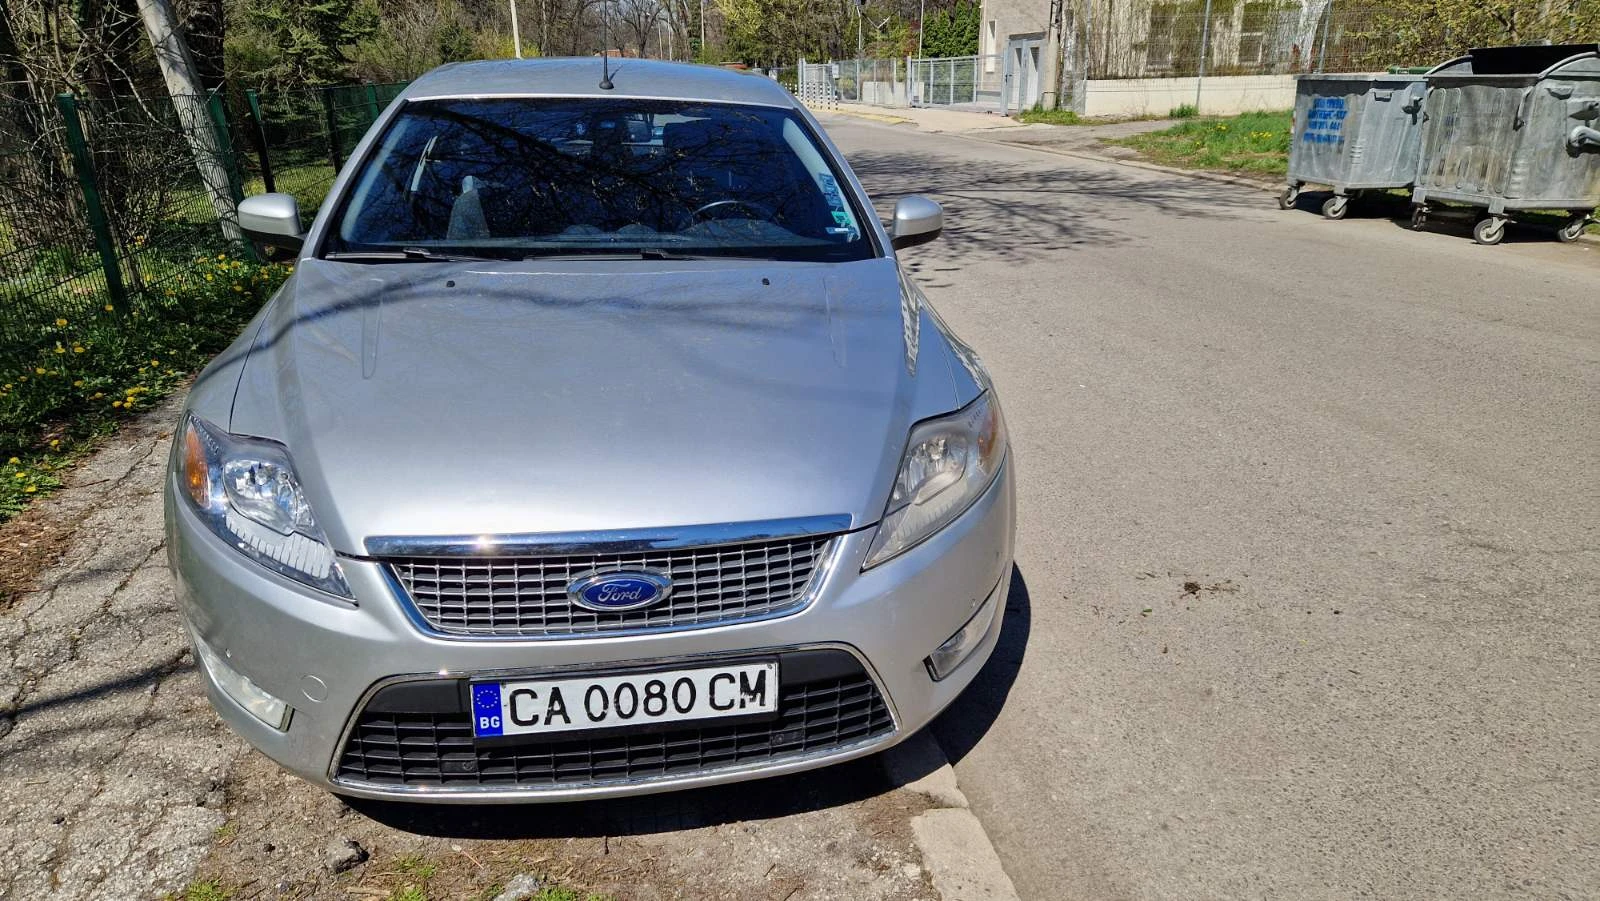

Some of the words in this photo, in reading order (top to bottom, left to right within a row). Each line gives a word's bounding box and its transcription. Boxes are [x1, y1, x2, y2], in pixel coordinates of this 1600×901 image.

[598, 583, 642, 602] Ford
[509, 686, 572, 727] CA
[584, 677, 697, 722] 0080
[708, 669, 767, 711] CM
[480, 716, 500, 729] BG
